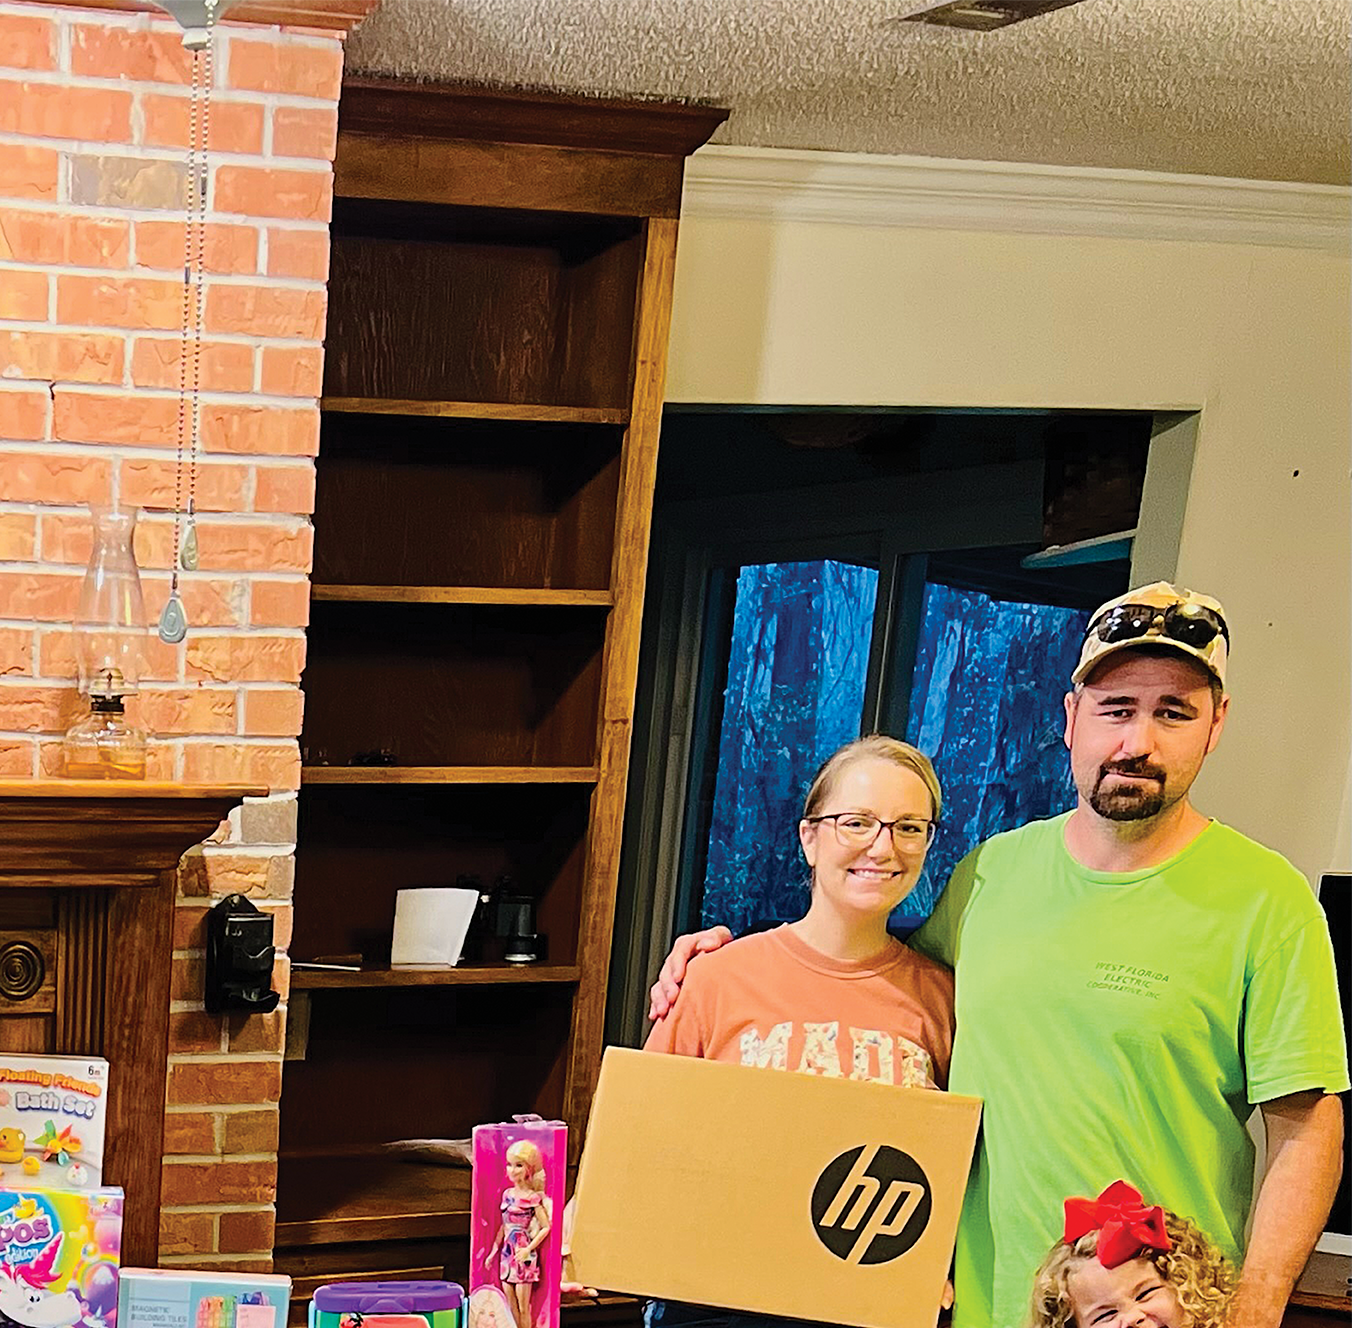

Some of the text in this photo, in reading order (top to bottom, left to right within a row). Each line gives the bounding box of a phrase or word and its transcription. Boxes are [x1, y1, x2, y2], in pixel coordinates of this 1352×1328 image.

[1095, 961, 1170, 982] WEST FLORIDA
[1103, 973, 1152, 989] ELECTRIC
[54, 1073, 102, 1097] Friends
[15, 1091, 96, 1119] Bath Set
[819, 1144, 925, 1266] hp
[5, 1247, 39, 1265] edition
